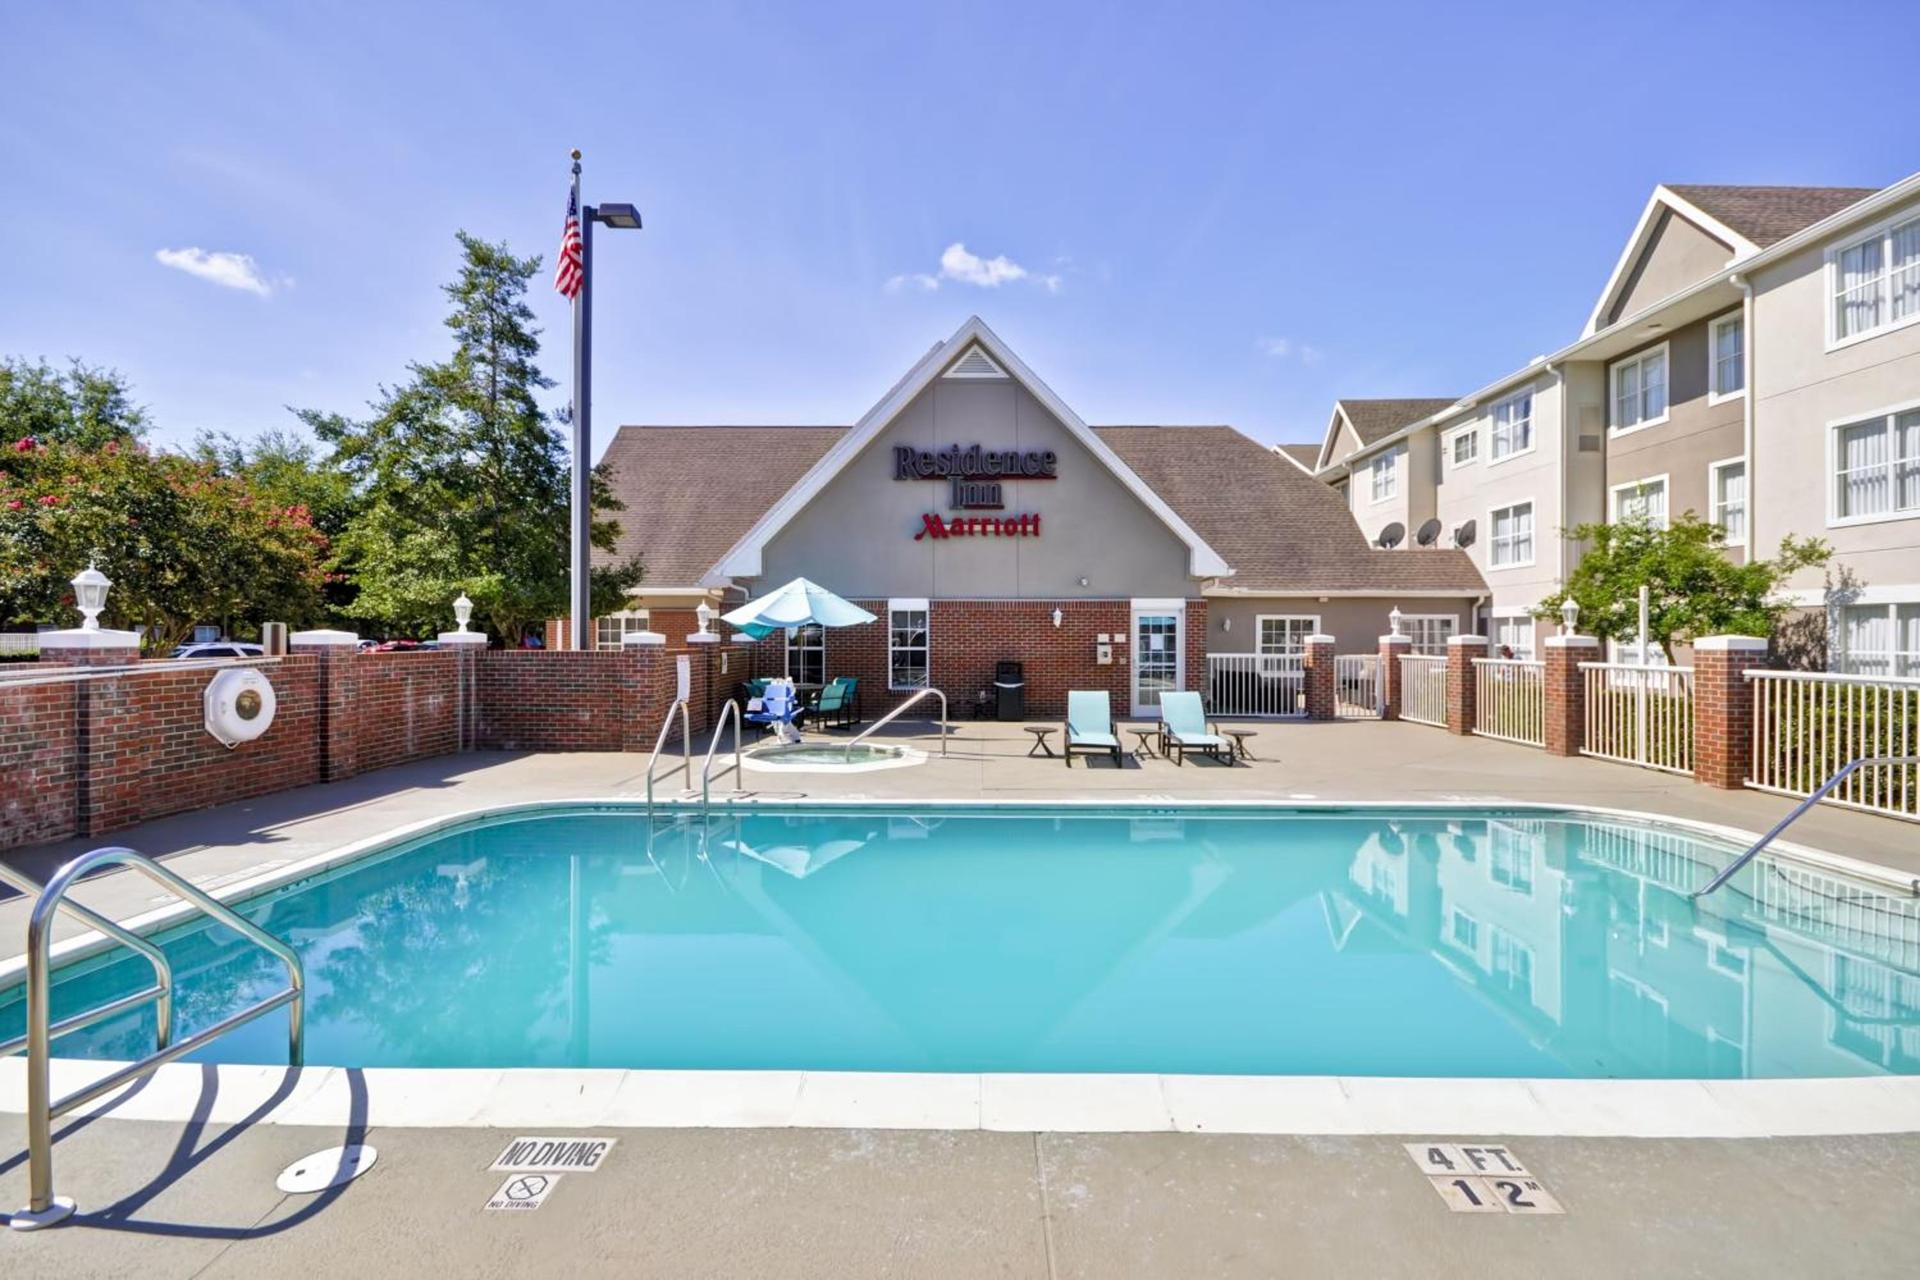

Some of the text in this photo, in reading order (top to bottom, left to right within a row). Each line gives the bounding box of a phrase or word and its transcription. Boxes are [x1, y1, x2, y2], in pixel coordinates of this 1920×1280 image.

[893, 443, 1057, 480] Residence
[948, 476, 1004, 509] Inn
[914, 513, 1041, 541] Marriott
[498, 1141, 607, 1167] NO DIVING
[1428, 1147, 1456, 1171] 4
[505, 1201, 539, 1209] DIVING
